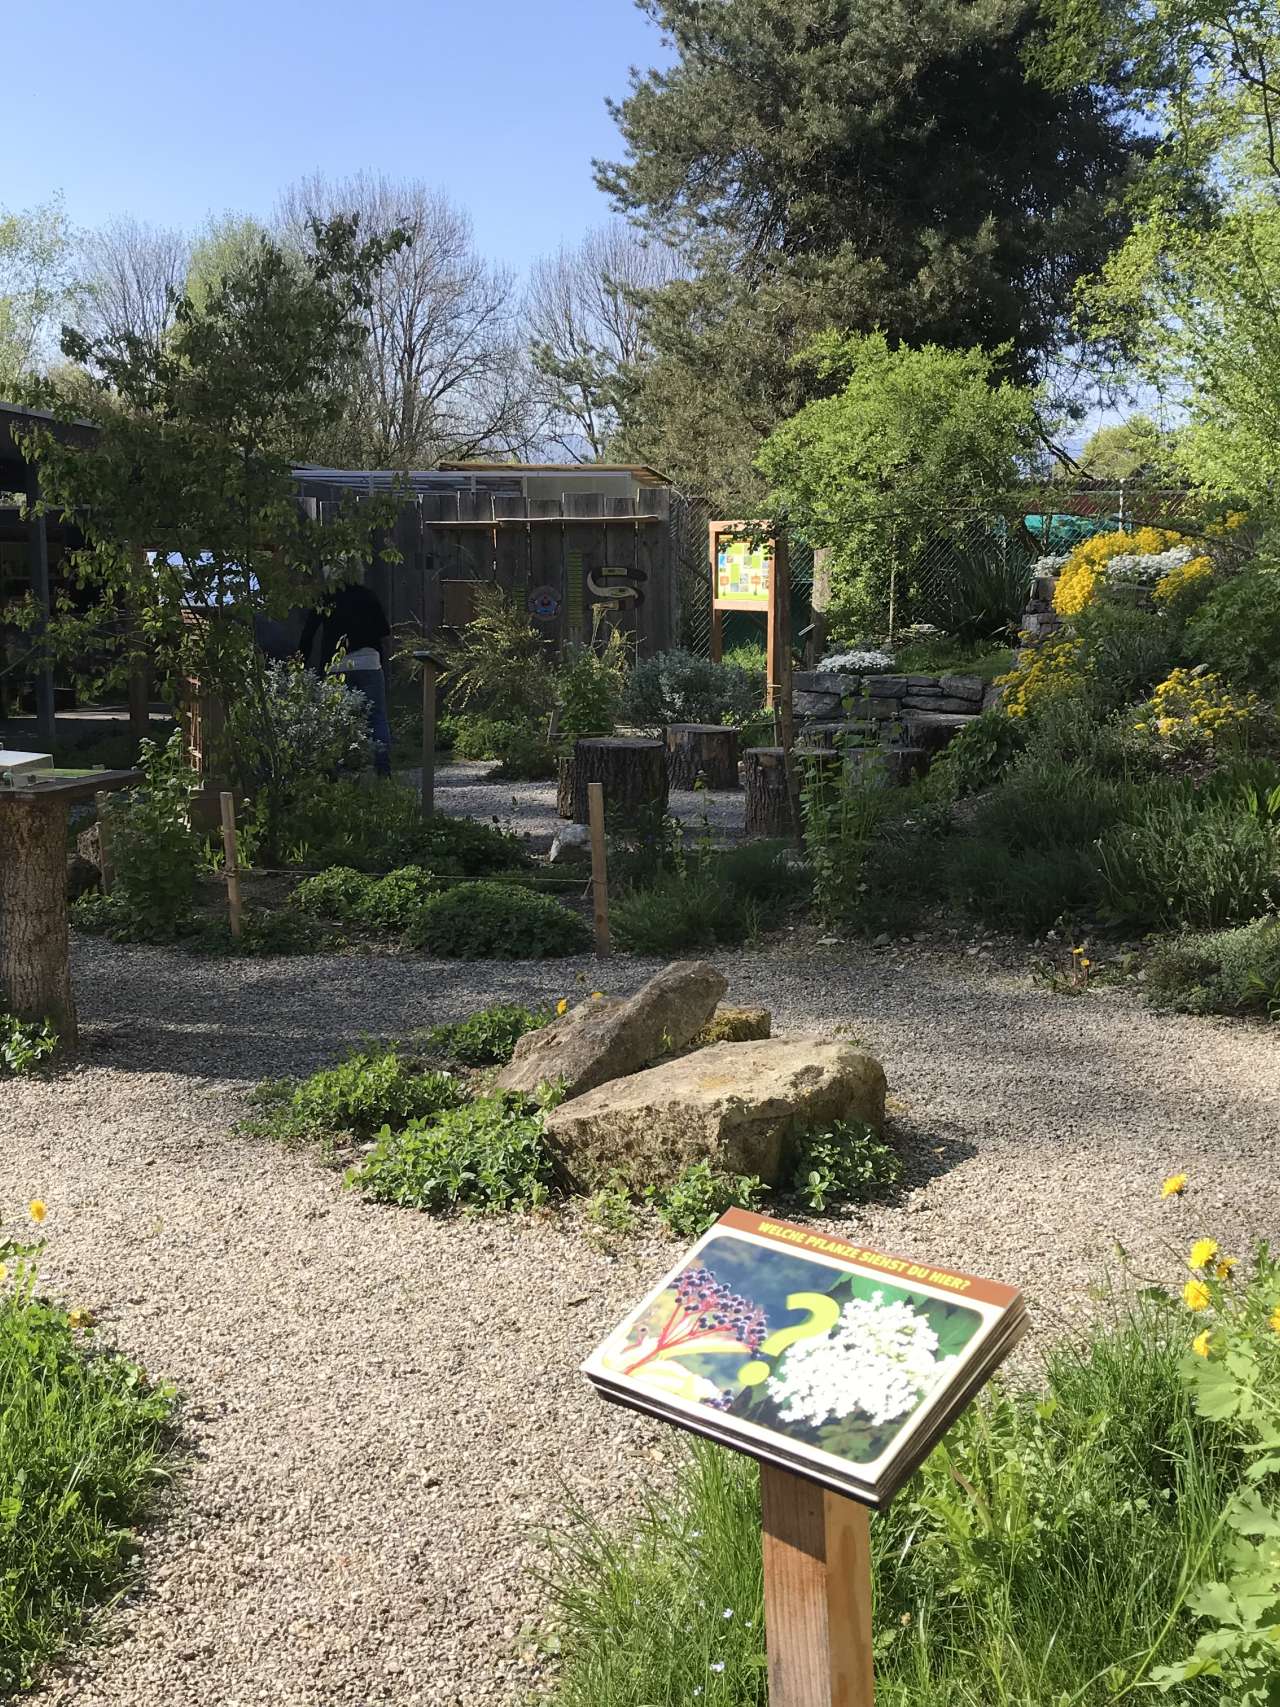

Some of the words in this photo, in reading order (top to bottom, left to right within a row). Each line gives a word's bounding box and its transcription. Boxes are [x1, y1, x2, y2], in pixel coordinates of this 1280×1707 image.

[758, 1221, 804, 1242] WELCHE
[805, 1236, 861, 1258] PFLANZE
[861, 1251, 910, 1272] SIEHST
[910, 1264, 930, 1279] DU
[930, 1270, 971, 1291] HIER?
